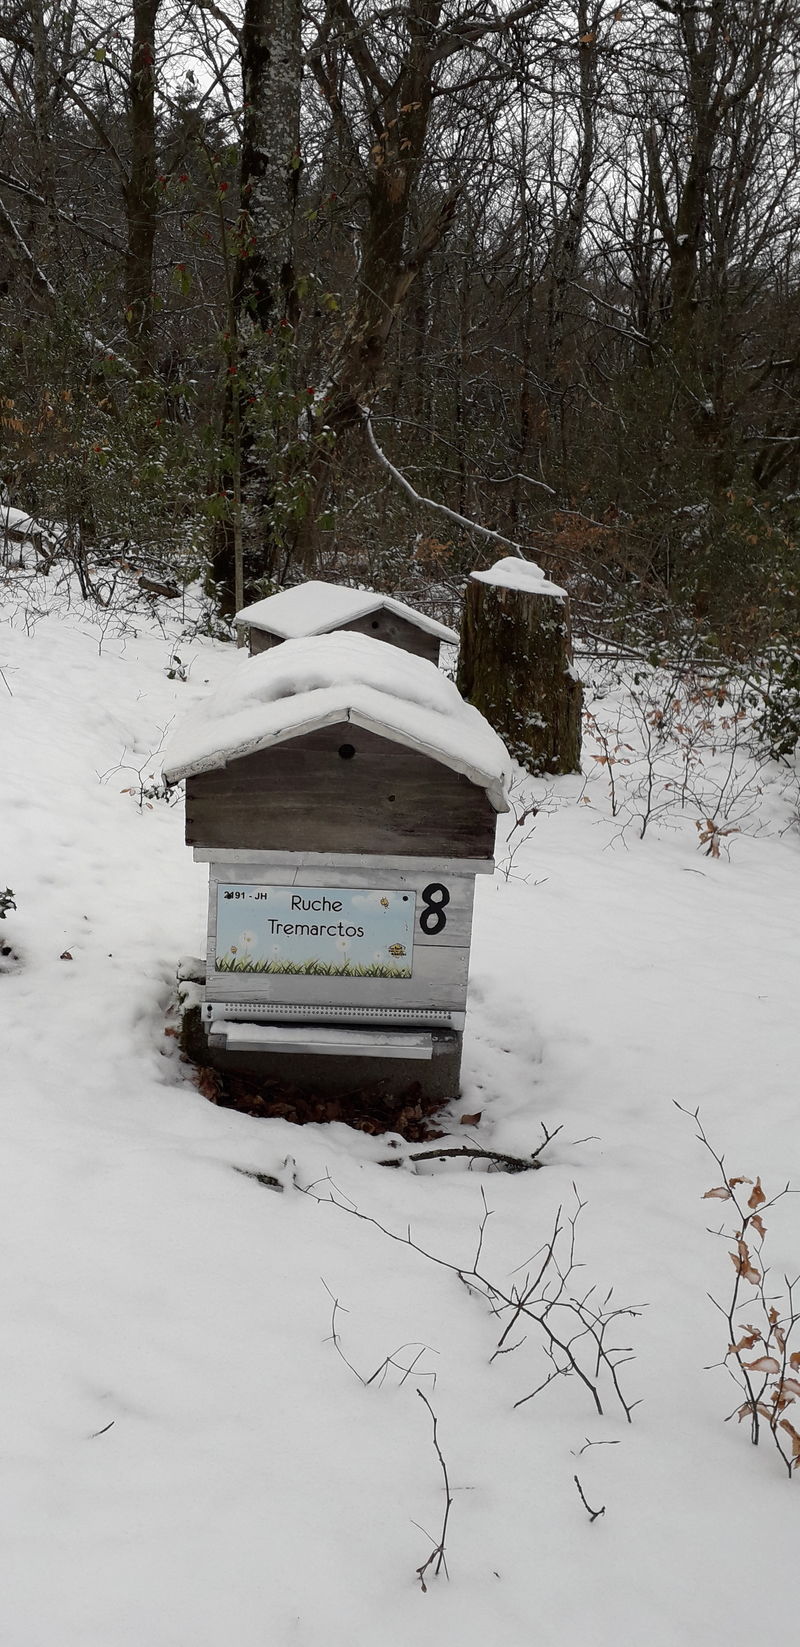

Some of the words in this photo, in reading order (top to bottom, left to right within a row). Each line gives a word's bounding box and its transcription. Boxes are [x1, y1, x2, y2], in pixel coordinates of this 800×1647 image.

[254, 892, 268, 900] JH
[291, 895, 343, 912] Ruche
[419, 883, 451, 936] 8
[267, 919, 365, 938] Tremarctos
